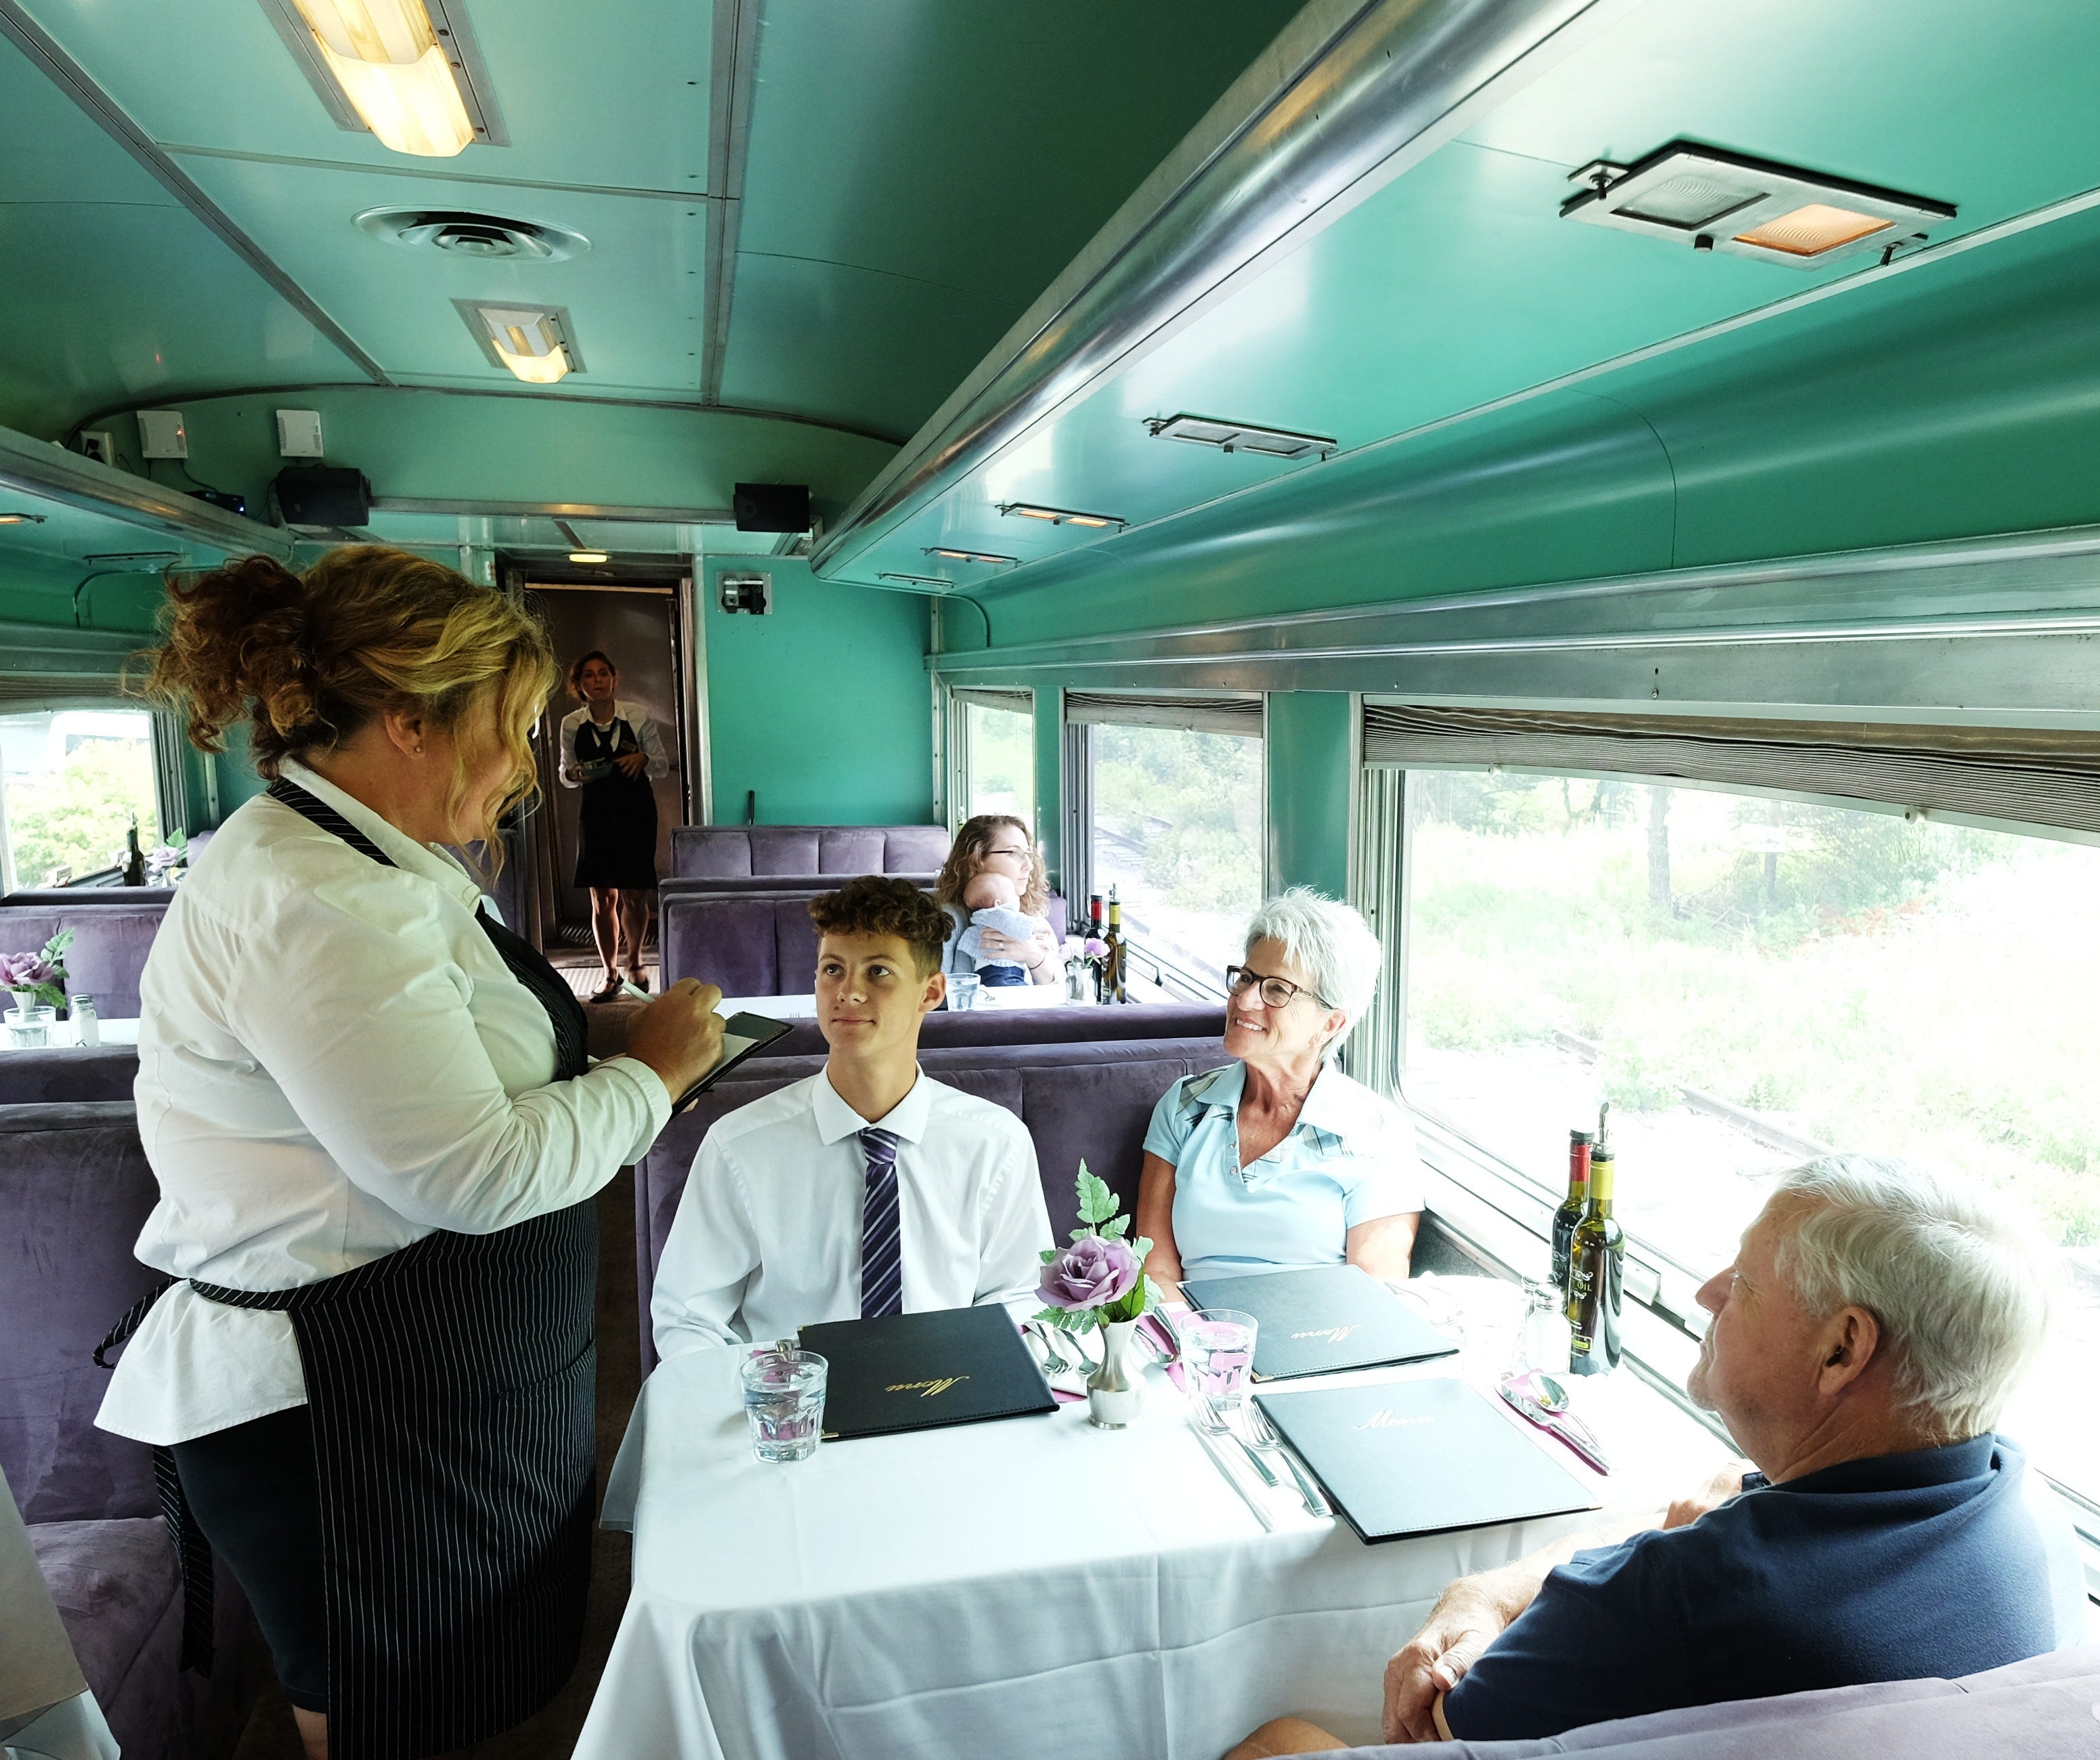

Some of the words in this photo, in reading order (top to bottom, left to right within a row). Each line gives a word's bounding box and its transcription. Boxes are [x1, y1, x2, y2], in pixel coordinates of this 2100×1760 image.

[1290, 1324, 1365, 1344] Menu
[884, 1375, 970, 1398] Menu
[1354, 1409, 1436, 1431] Menu
